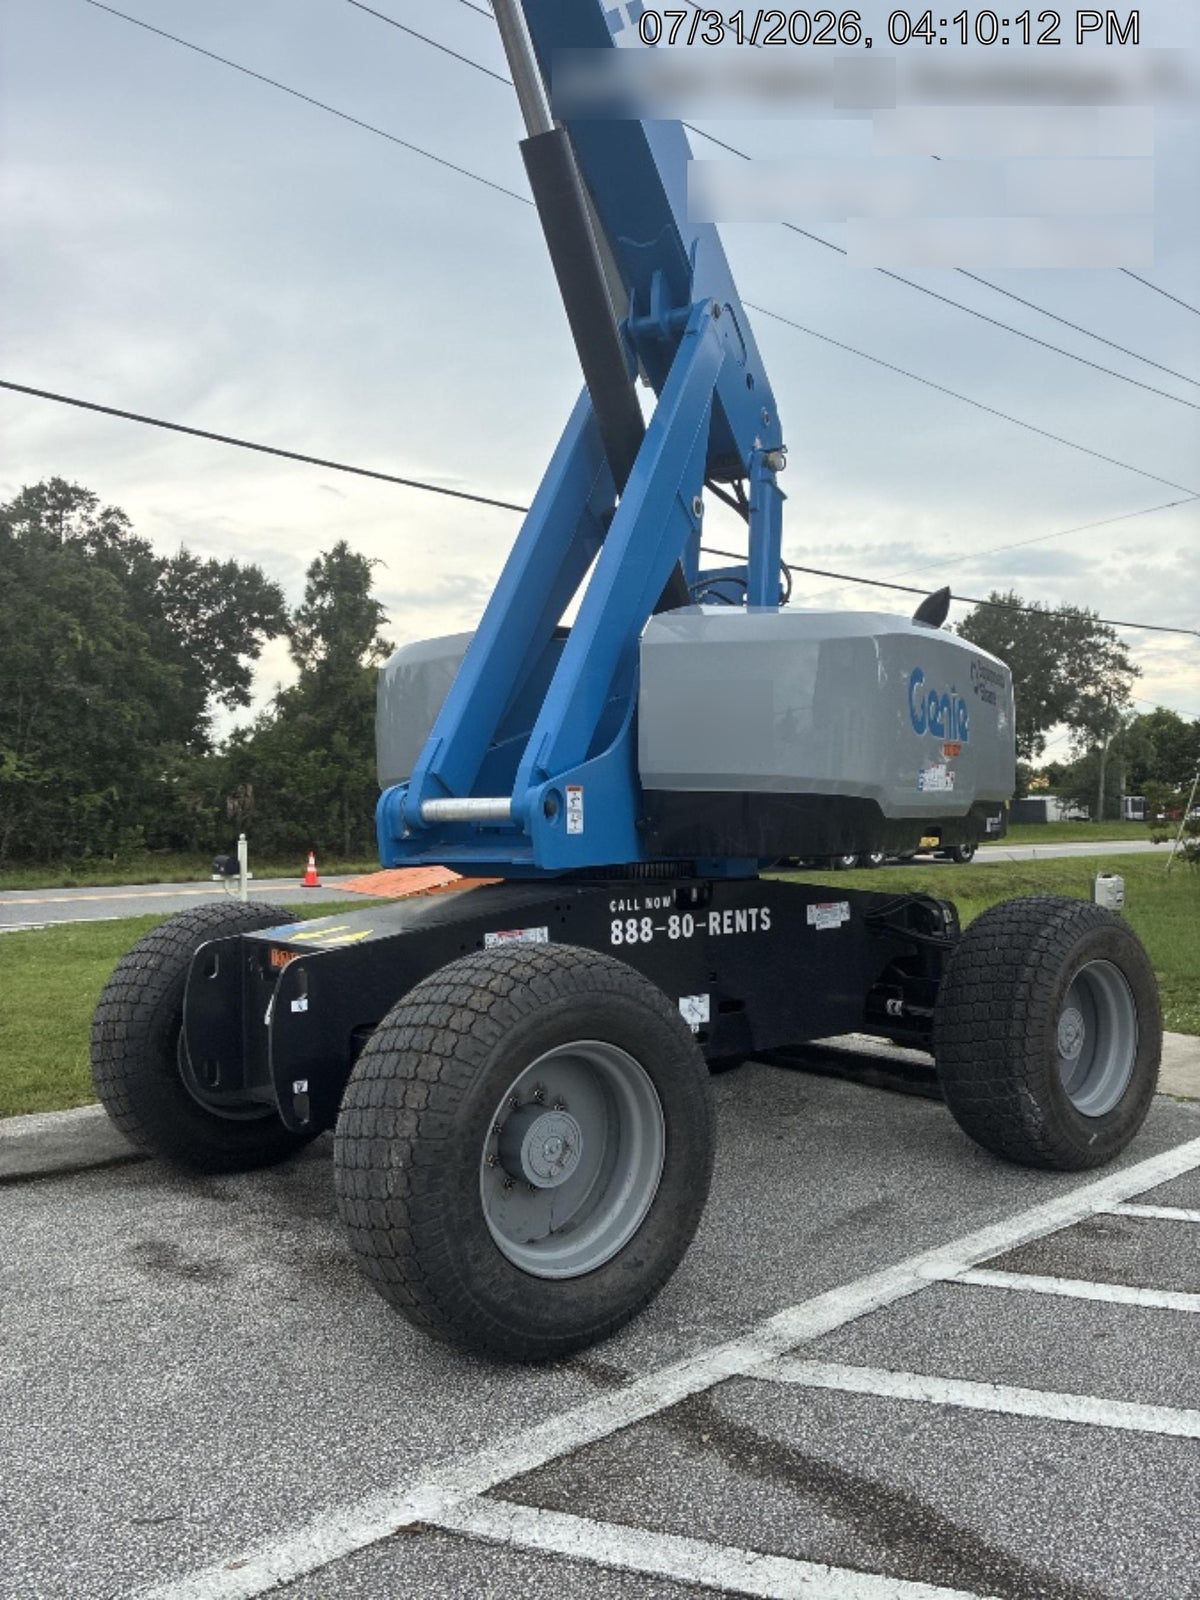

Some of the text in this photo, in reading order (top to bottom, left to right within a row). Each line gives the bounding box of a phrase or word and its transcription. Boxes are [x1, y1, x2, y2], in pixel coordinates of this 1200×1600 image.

[909, 666, 969, 742] Genie
[609, 895, 672, 913] CALL NOW
[610, 906, 772, 946] 888-80-RENTS
